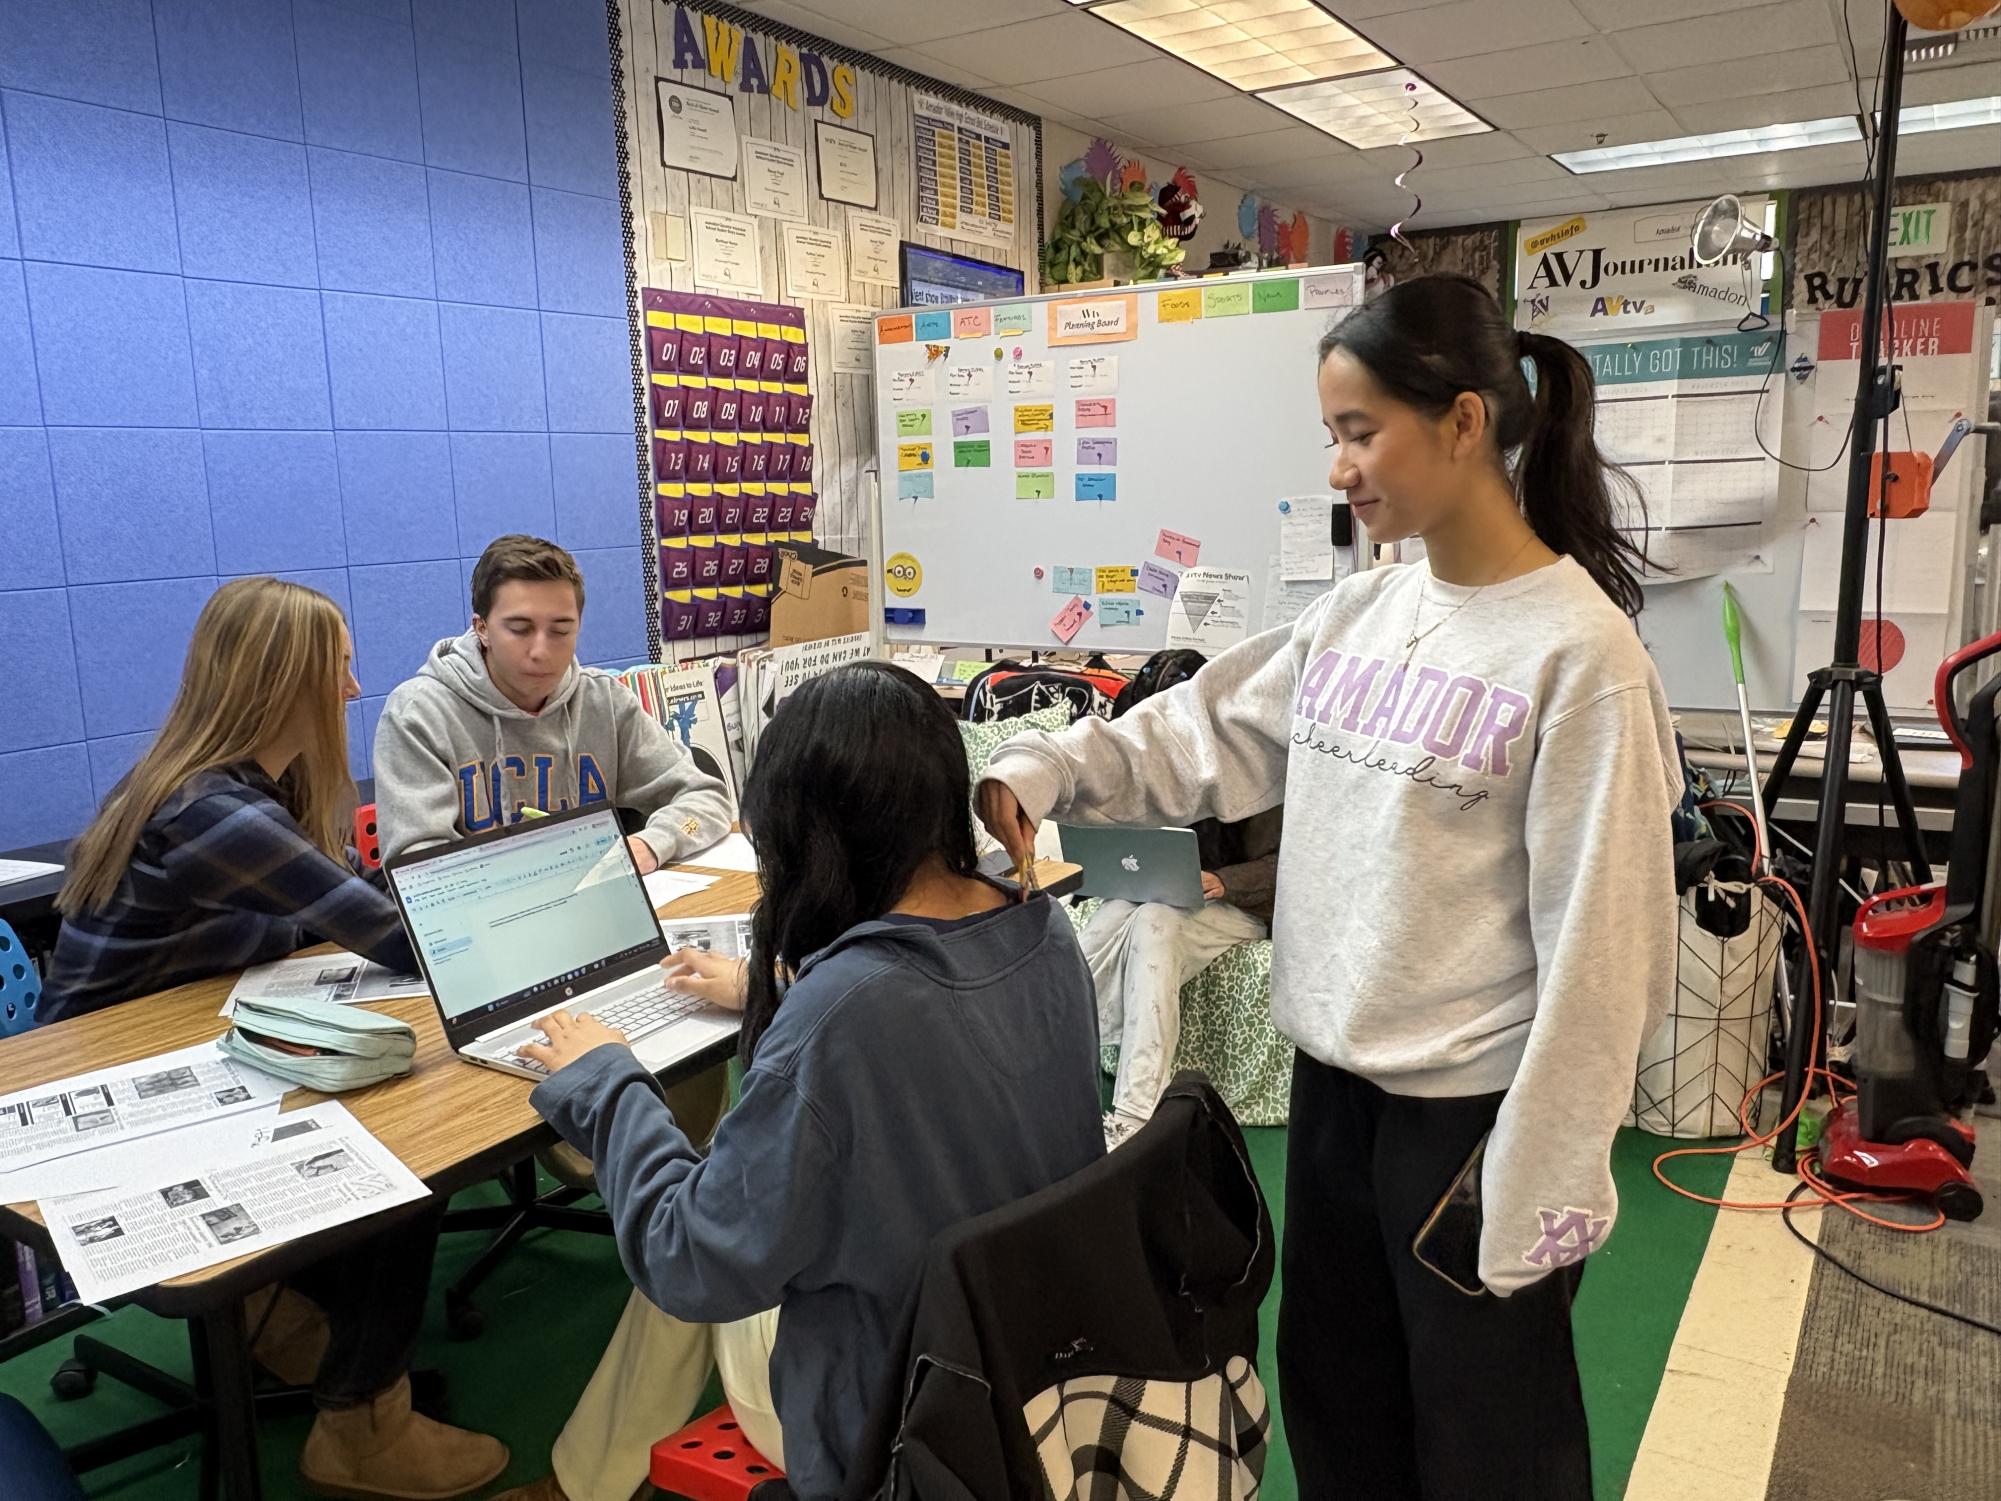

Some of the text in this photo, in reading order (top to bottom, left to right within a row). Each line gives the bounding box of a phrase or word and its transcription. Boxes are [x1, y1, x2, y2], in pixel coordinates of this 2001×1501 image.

[672, 7, 855, 119] AWARDS
[1888, 208, 1936, 247] EXIT
[1804, 252, 2001, 309] RURICS
[959, 315, 982, 327] ATC
[1064, 316, 1120, 331] Planning Board
[1850, 317, 1941, 342] DDLINE
[662, 342, 806, 372] 01 02 03 04 05 06
[1590, 344, 1738, 377] TALLY GOT THIS!
[1849, 337, 1939, 361] TACKER
[665, 400, 810, 424] 07 08 09 10 11 12
[669, 453, 812, 473] 13 14 15 16 17 18
[673, 509, 688, 526] 19
[699, 507, 713, 524] 20
[726, 508, 740, 524] 21
[752, 508, 769, 523] 22
[778, 507, 792, 522] 23
[703, 560, 718, 577] 26
[728, 559, 744, 575] 27
[754, 558, 769, 574] 28
[677, 615, 692, 631] 31
[705, 611, 721, 628] 32
[731, 609, 747, 624] 33
[802, 655, 817, 669] FOR
[819, 653, 830, 665] DO
[832, 649, 847, 663] CAN
[862, 646, 871, 658] AT
[780, 657, 800, 676] YOU!
[1296, 648, 1533, 777] AMADOR
[1290, 722, 1489, 811] cheerleading
[458, 752, 608, 836] UCLA
